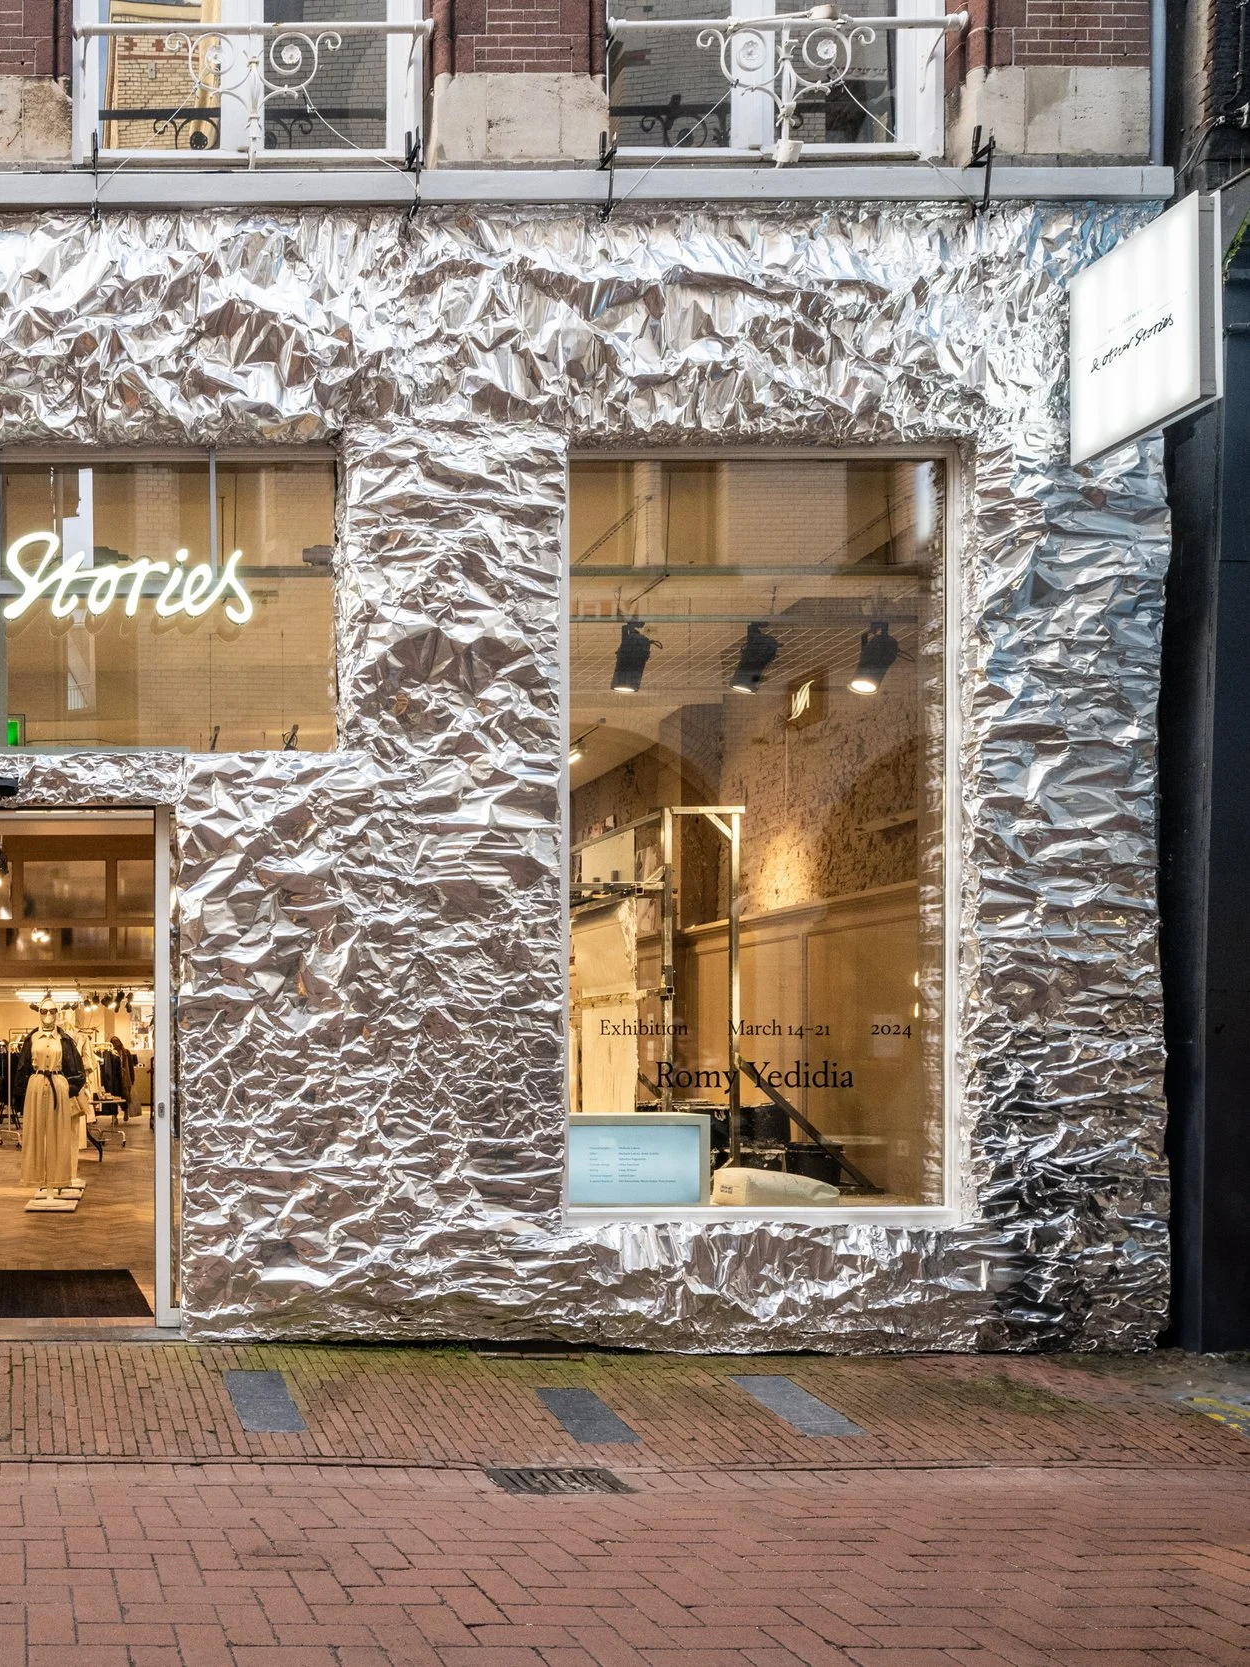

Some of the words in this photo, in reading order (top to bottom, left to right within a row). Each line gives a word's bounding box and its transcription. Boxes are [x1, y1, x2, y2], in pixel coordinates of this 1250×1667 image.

[1090, 358, 1101, 374] &
[1102, 336, 1134, 366] other
[1135, 313, 1174, 346] Stories
[3, 531, 254, 625] Stories
[600, 1019, 689, 1036] Exhibition
[728, 1019, 783, 1036] March
[871, 1023, 913, 1039] 2024
[655, 1061, 739, 1095] Romy
[749, 1060, 855, 1089] Yedidia
